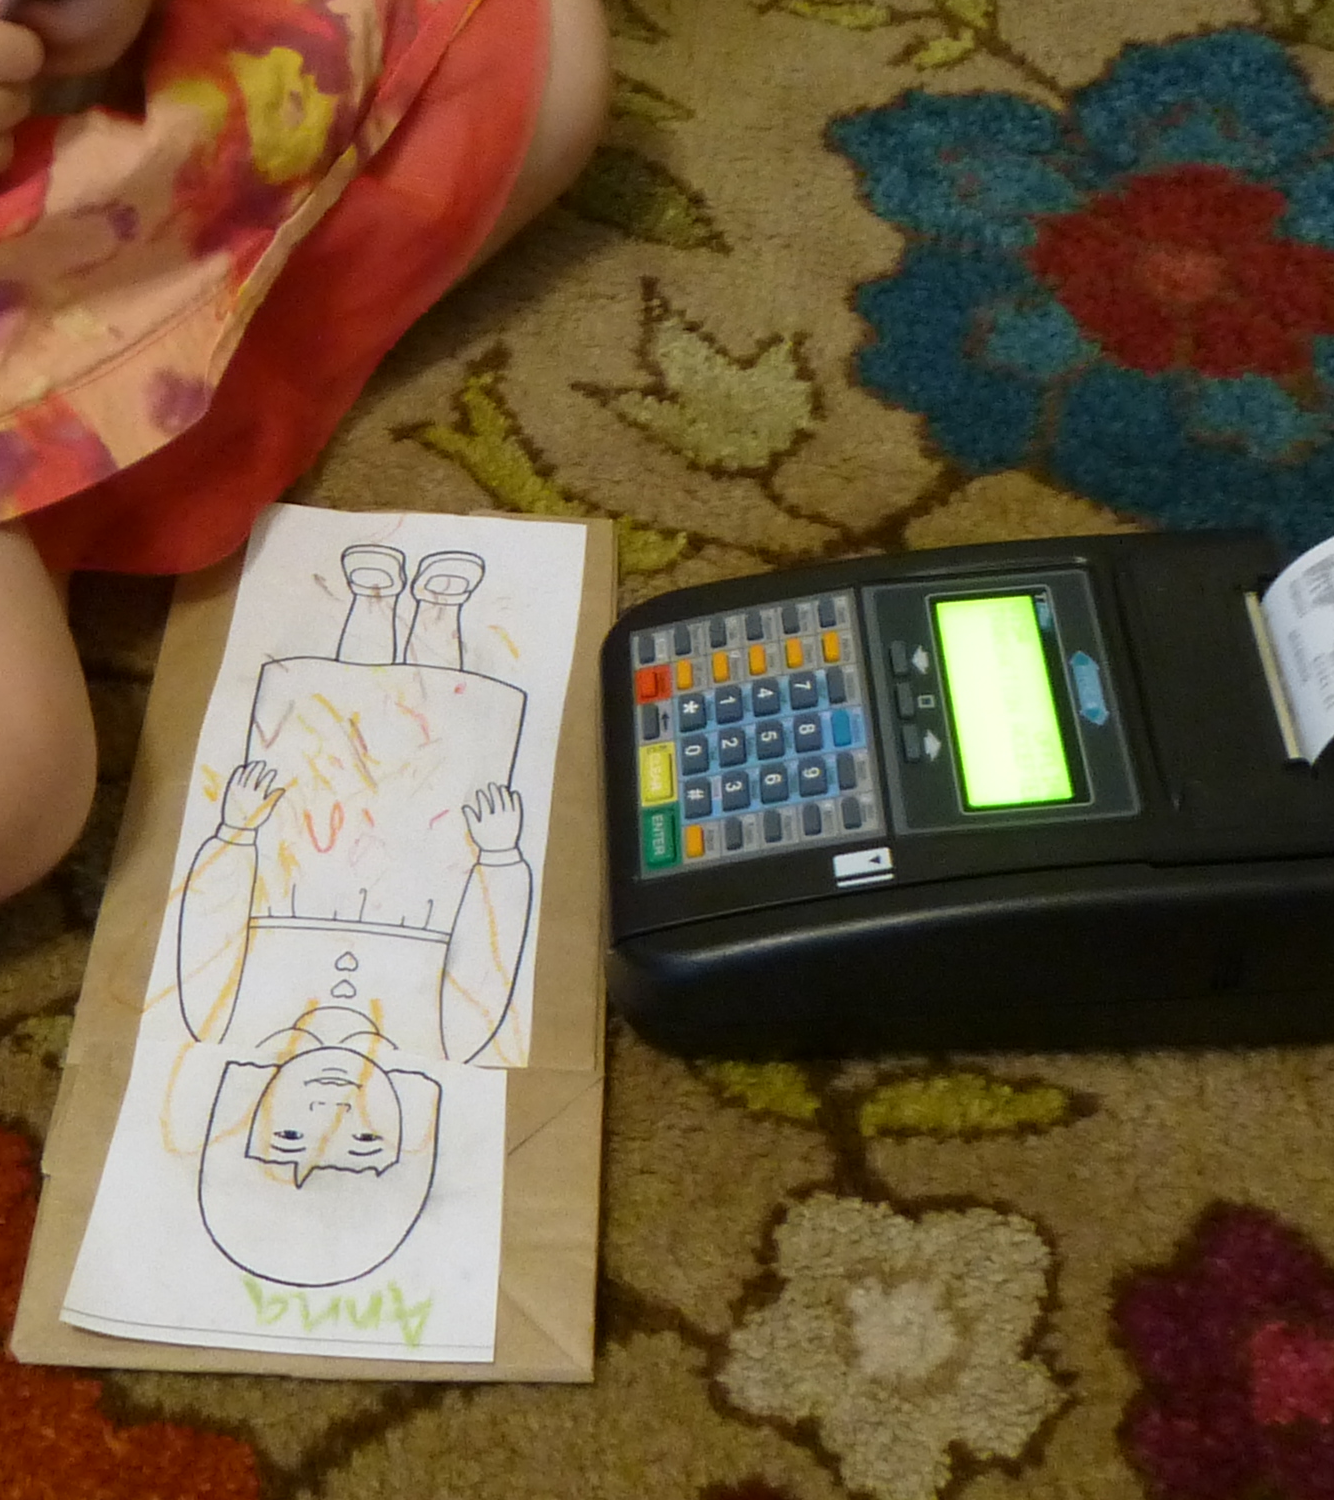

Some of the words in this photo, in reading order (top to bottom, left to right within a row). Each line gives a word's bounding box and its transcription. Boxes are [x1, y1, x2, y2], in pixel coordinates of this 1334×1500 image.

[794, 680, 812, 690] 7
[757, 687, 774, 698] 4
[719, 695, 736, 705] 1
[798, 723, 816, 735] 8
[760, 731, 778, 742] 5
[721, 737, 739, 749] 2
[684, 745, 702, 756] 0
[649, 754, 662, 793] CLEAR
[764, 773, 782, 785] 6
[802, 767, 820, 779] 9
[725, 781, 743, 793] 3
[651, 813, 665, 855] ENTER
[243, 1275, 434, 1350] Anna
